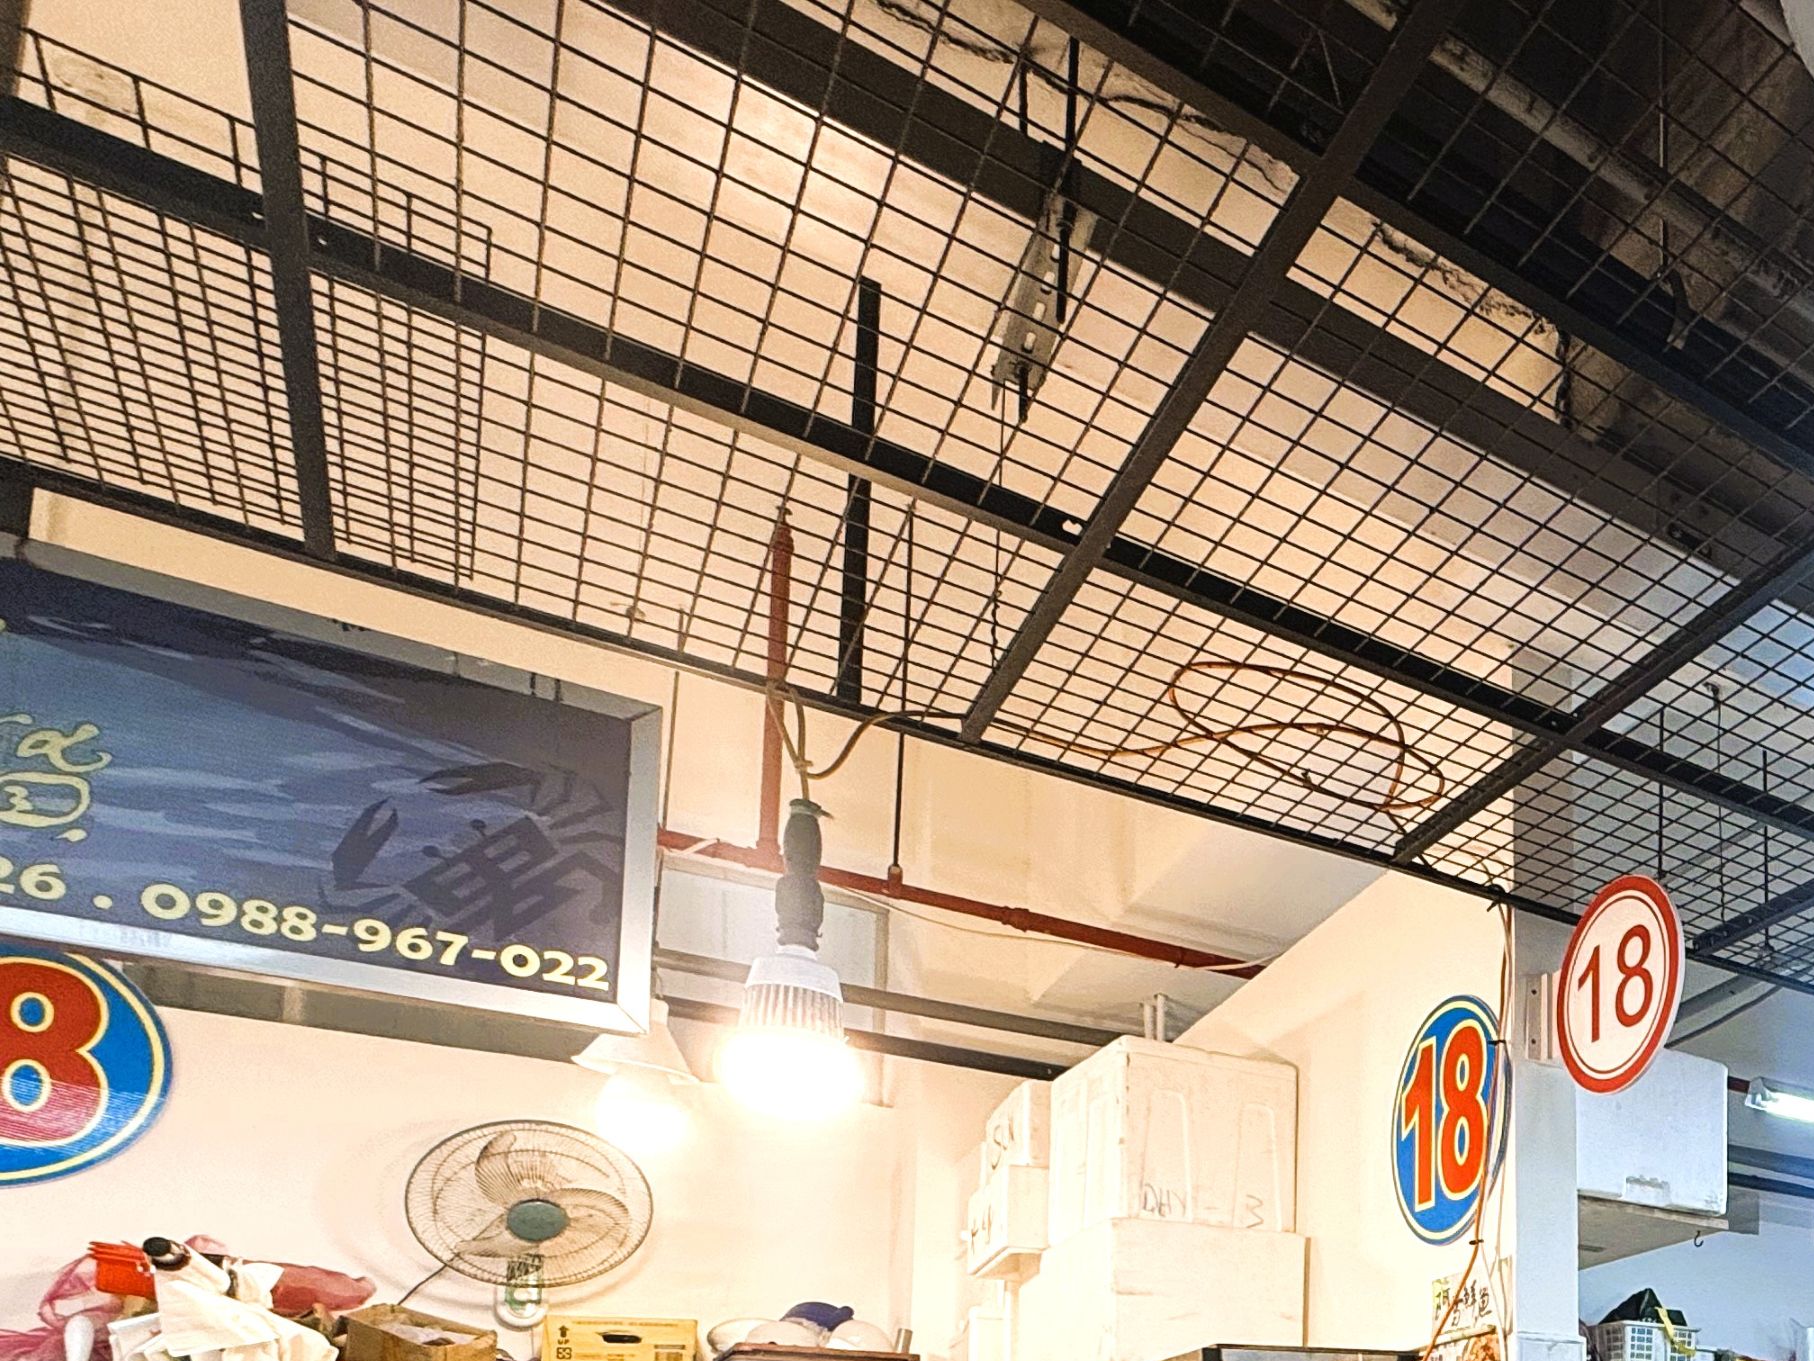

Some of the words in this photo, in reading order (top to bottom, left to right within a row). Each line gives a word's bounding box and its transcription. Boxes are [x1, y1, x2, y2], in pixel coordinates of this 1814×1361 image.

[140, 884, 610, 991] 0988-967-022
[1578, 924, 1653, 1043] 18
[0, 956, 109, 1148] 8
[1401, 1019, 1489, 1213] 18
